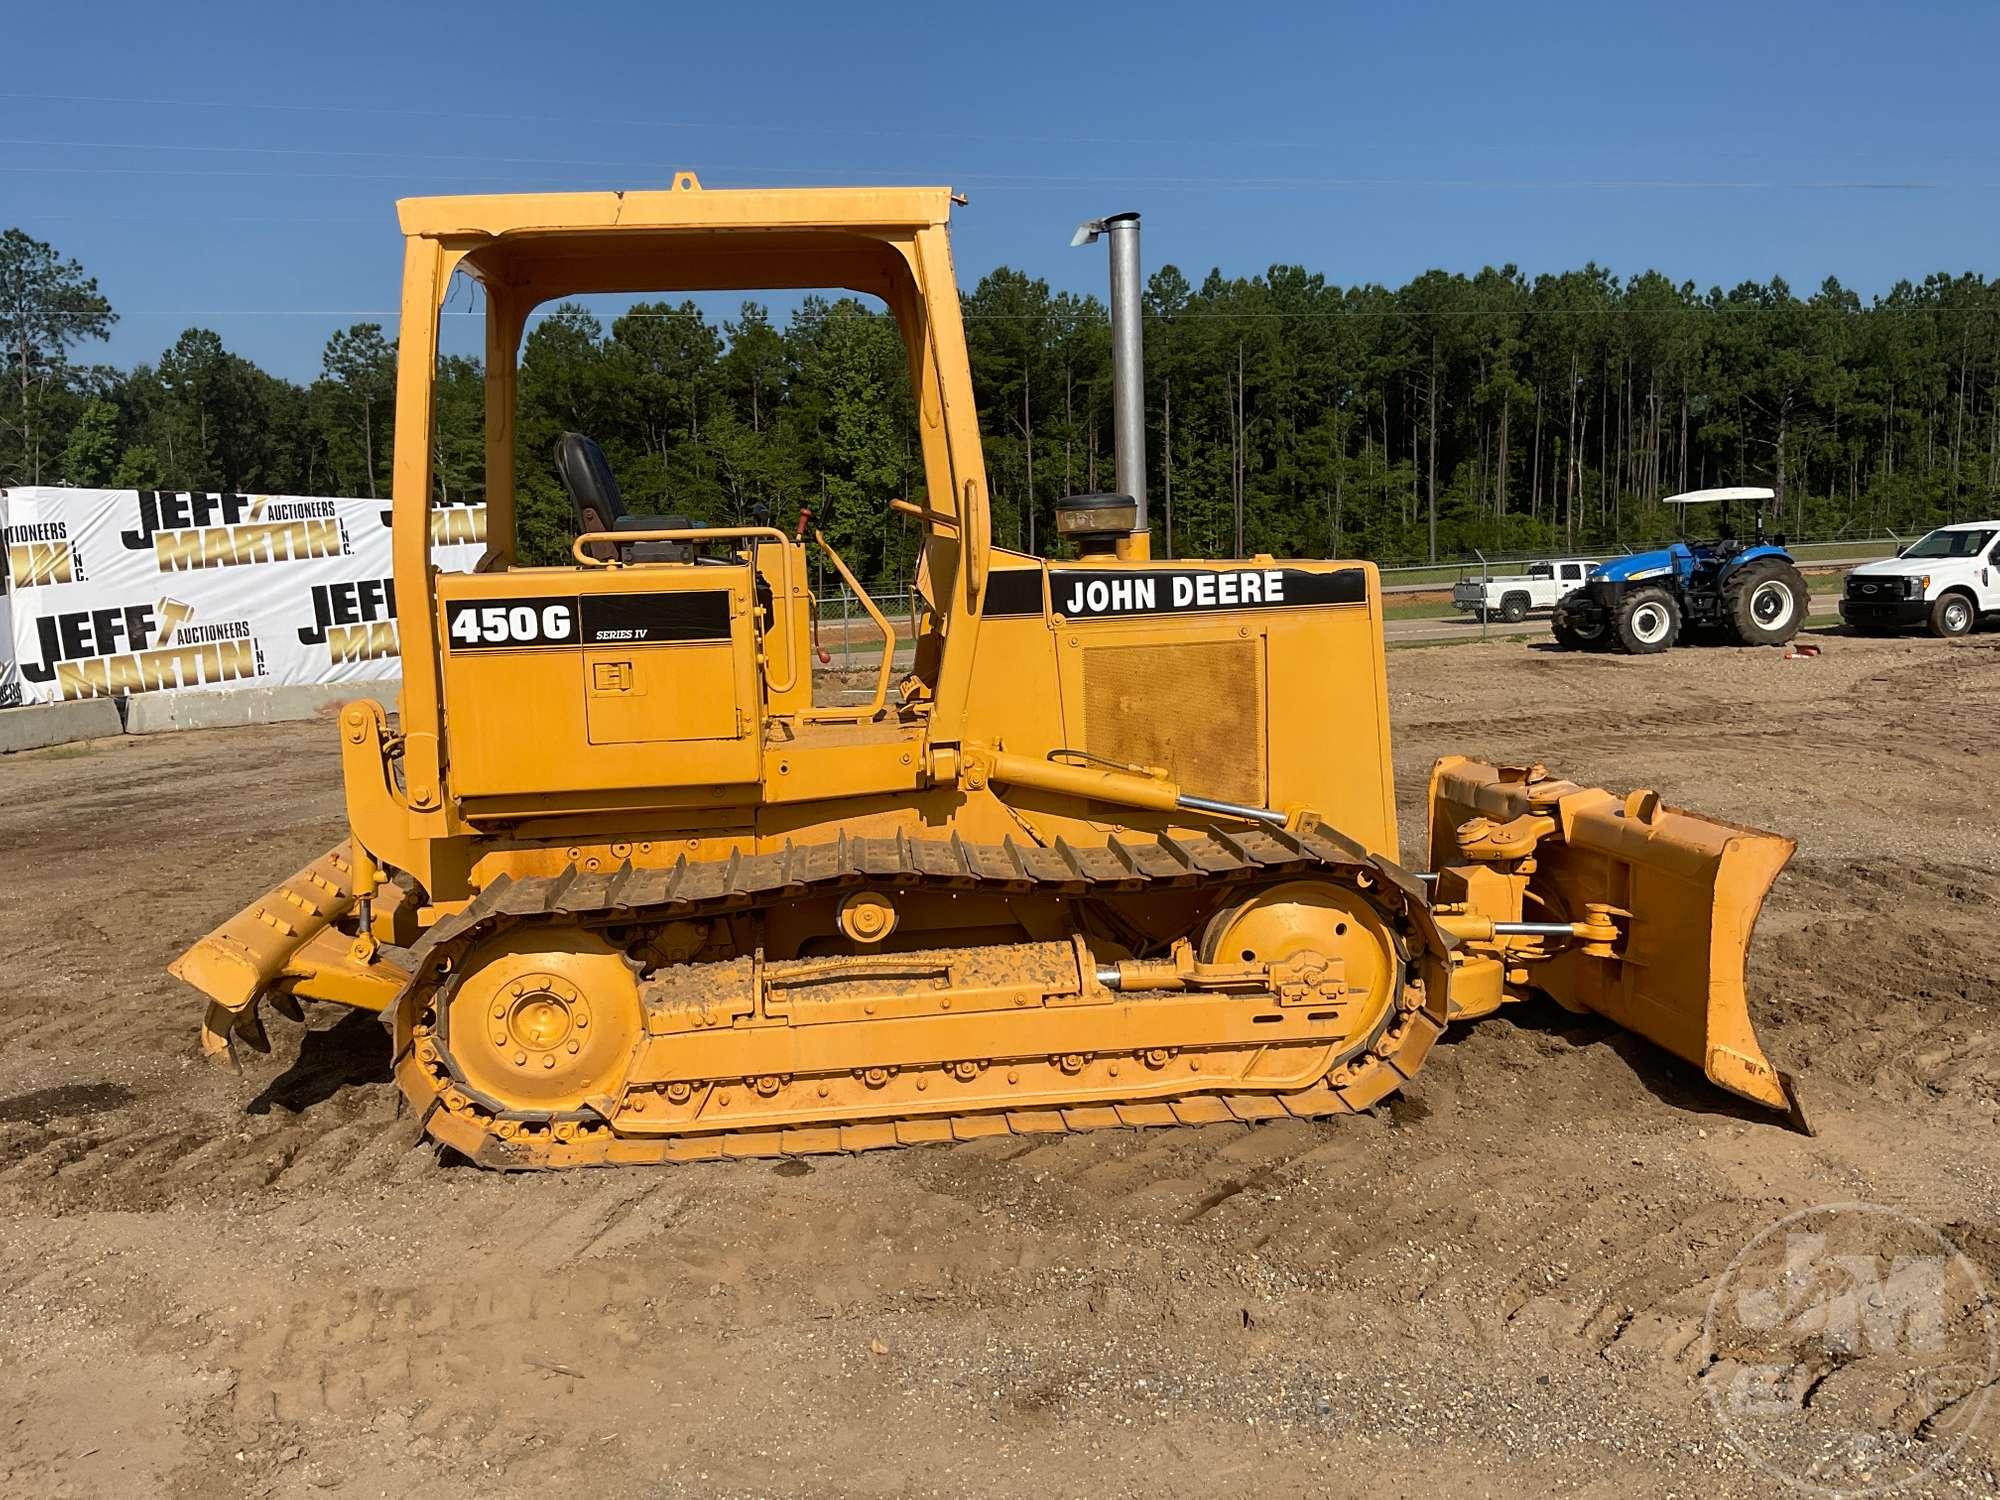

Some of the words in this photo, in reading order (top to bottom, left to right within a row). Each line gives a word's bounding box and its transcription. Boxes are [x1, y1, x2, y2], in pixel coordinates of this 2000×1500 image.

[8, 521, 67, 543] TIONEERS
[120, 490, 248, 550] JEFF
[267, 501, 336, 521] AUCTIONEERS
[155, 518, 341, 573] MARTIN
[1067, 578, 1156, 613] JOHN
[1173, 571, 1284, 607] DEERE
[20, 604, 157, 683] JEFF
[177, 621, 250, 645] AUCTIONEERS
[596, 630, 632, 640] SERIES
[634, 629, 648, 639] IV
[57, 638, 254, 700] MARTIN
